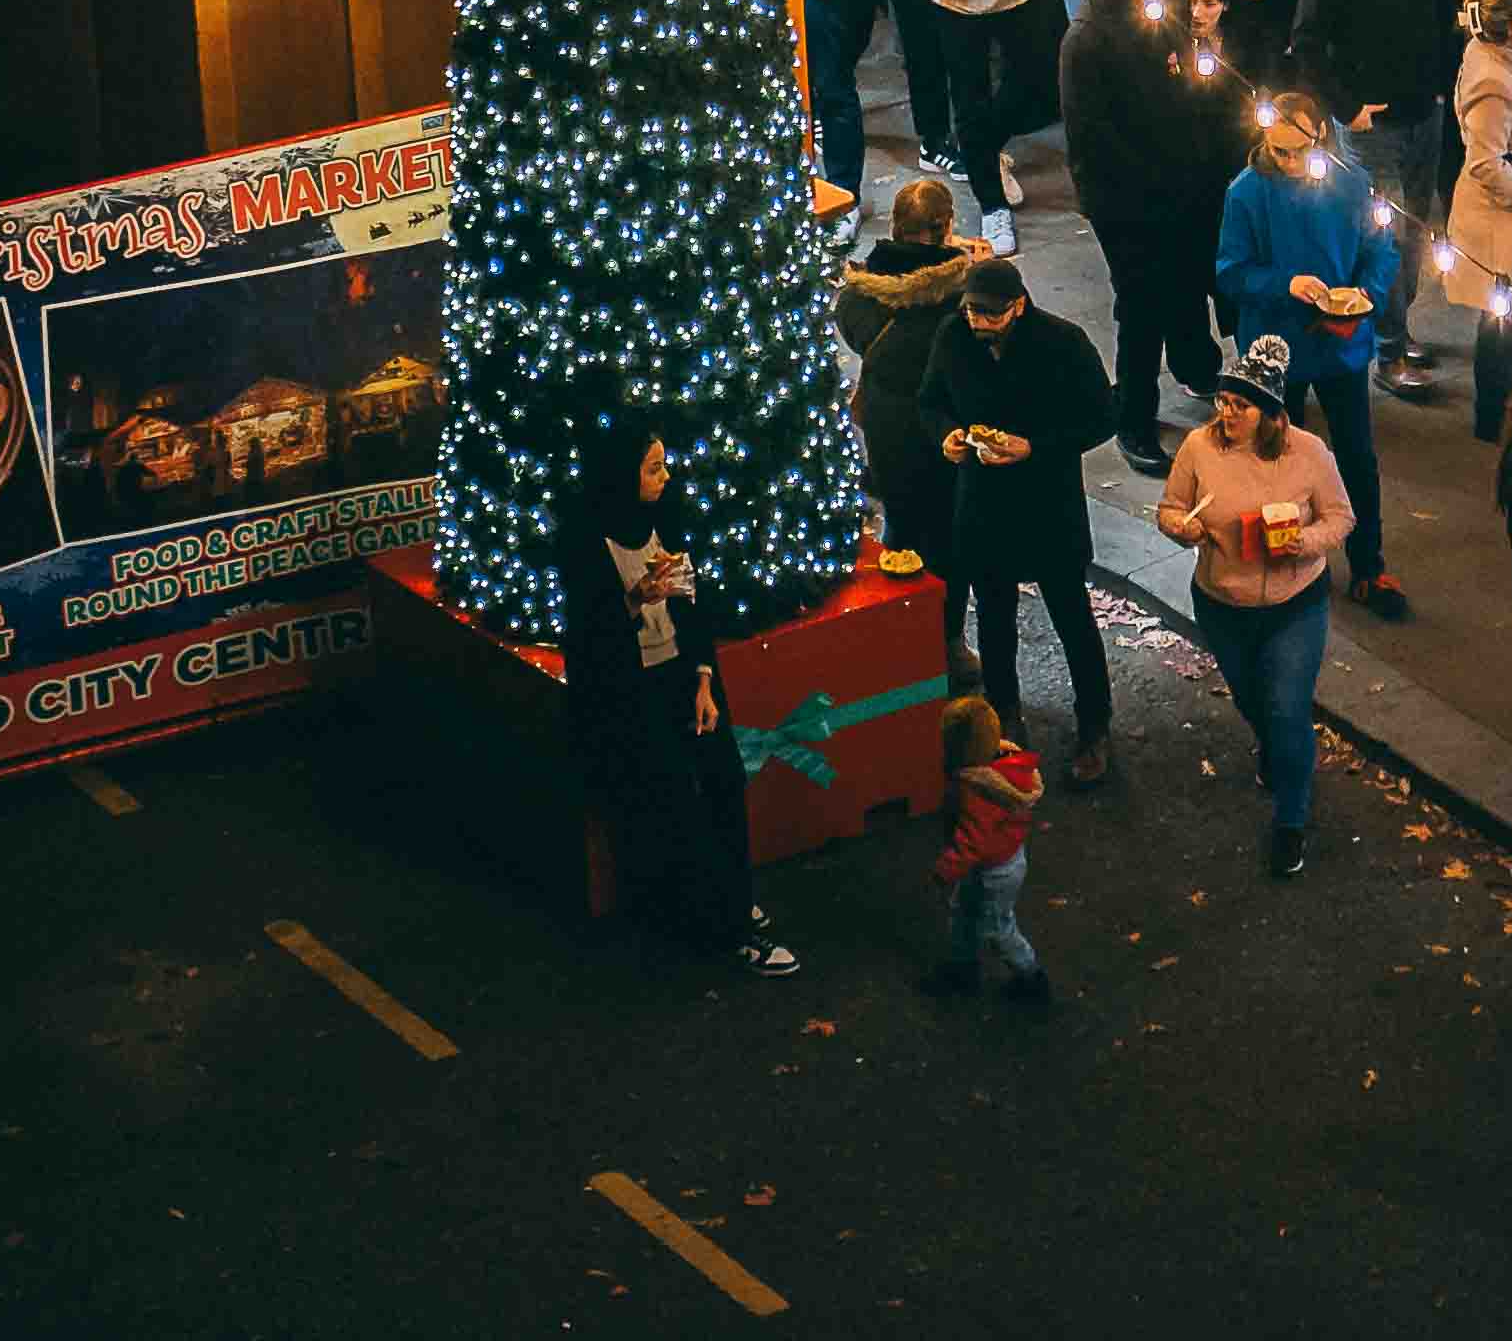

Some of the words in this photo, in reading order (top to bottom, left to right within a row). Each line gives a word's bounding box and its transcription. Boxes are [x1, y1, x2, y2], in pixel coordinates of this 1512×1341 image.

[63, 574, 182, 628] ROUND
[182, 560, 249, 599] THE
[248, 531, 352, 583] PEACE
[352, 516, 440, 556] GARD
[111, 537, 207, 583] FOOD
[204, 529, 231, 558] &
[231, 501, 335, 552] CRAFT
[25, 652, 164, 724] CITY
[173, 604, 372, 687] CENTR
